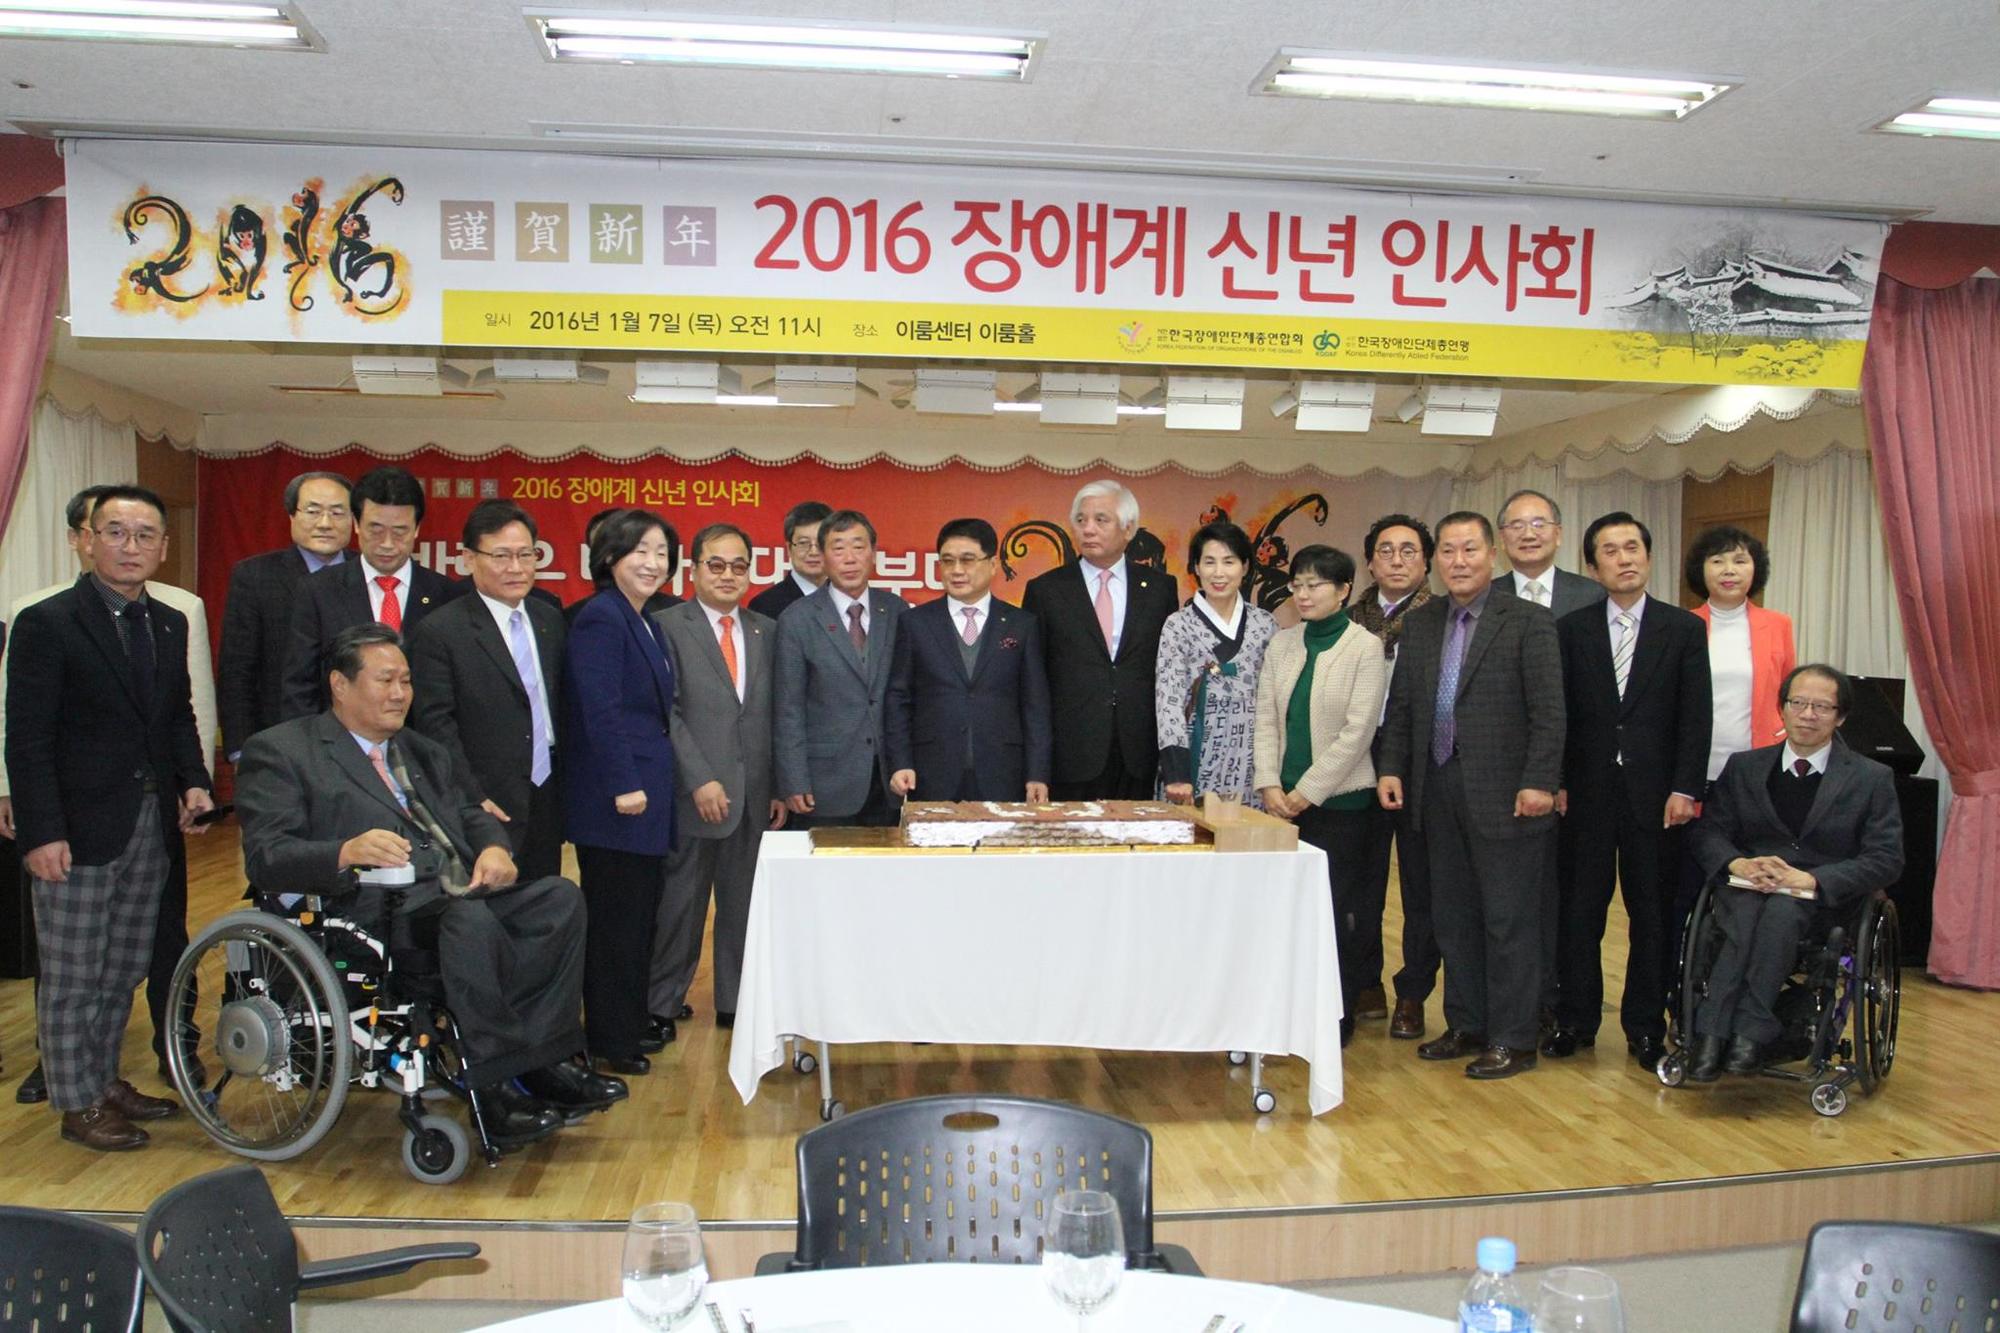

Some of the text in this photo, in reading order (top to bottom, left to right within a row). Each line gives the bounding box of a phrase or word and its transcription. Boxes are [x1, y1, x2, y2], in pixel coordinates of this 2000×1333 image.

[755, 195, 1595, 316] 2016 장애계 신년 인사회
[484, 310, 822, 339] 일시 2016년 1월 7일 (목) 오전 11시
[852, 320, 1036, 344] 장소 이룸센터 이룸홀
[1168, 328, 1304, 347] 한국장애인단체총연합회
[1357, 335, 1470, 353] 한국장애인단체총연맹
[512, 477, 761, 509] 2016 장애계 신년 인사회
